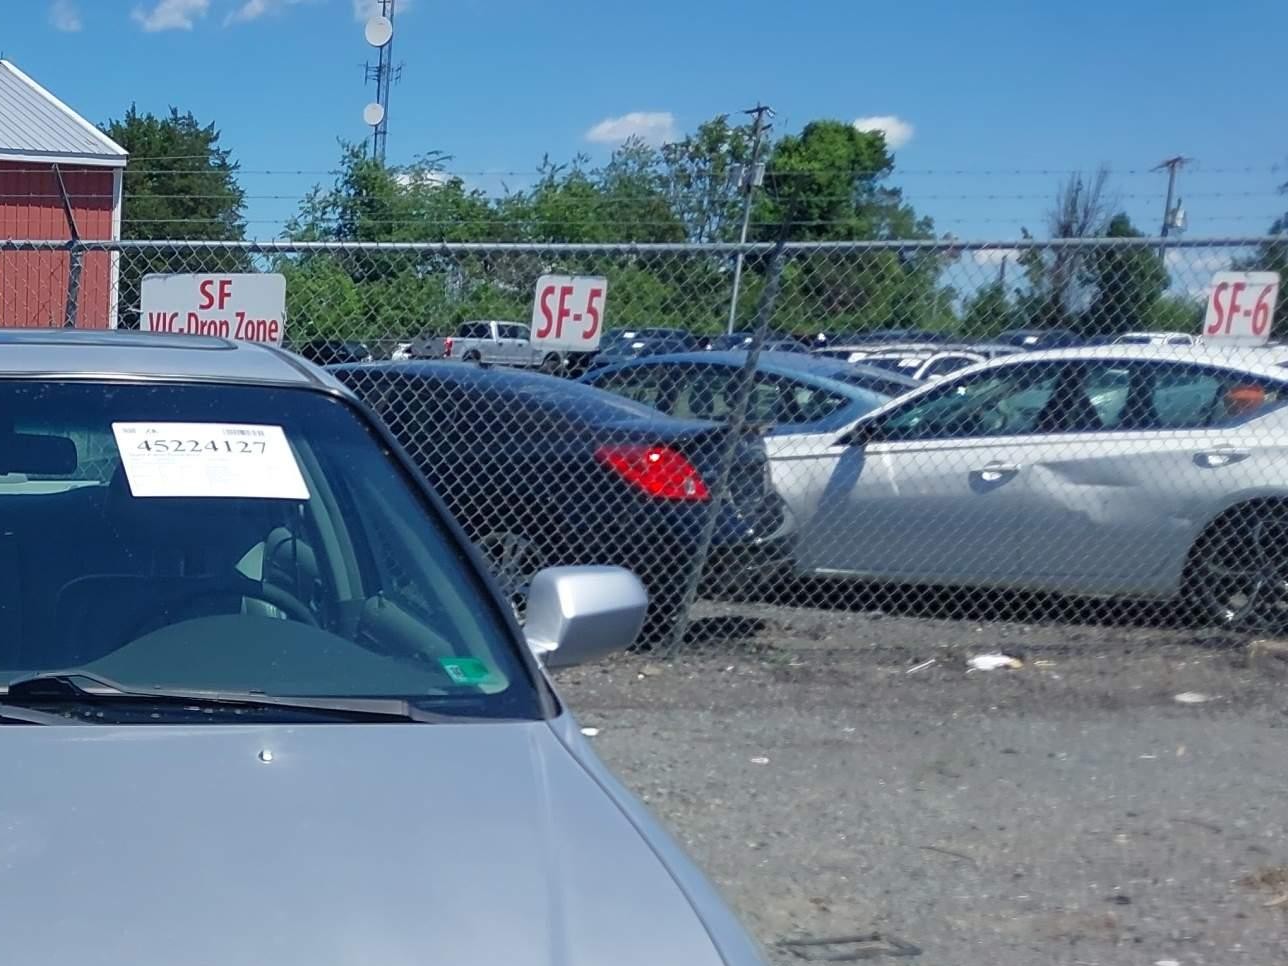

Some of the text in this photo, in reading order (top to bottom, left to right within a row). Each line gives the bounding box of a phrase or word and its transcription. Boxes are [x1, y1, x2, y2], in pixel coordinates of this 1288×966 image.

[199, 279, 233, 311] SF
[1207, 282, 1273, 335] SF-6
[234, 312, 279, 342] Zone
[535, 286, 603, 340] SF-5
[136, 438, 267, 455] 45224127
